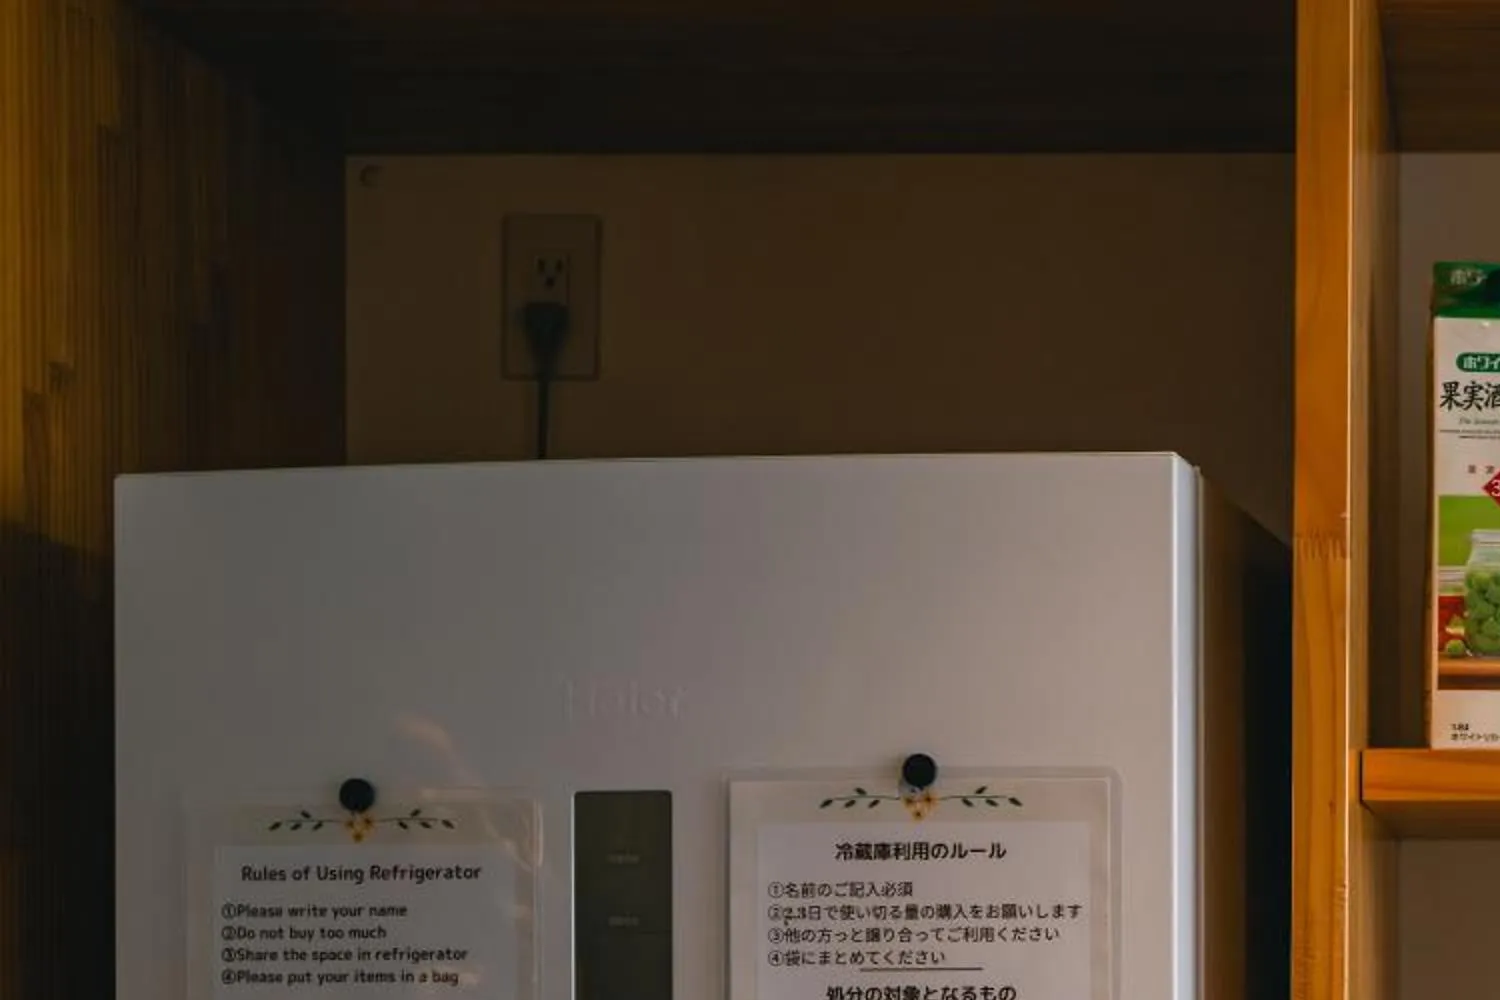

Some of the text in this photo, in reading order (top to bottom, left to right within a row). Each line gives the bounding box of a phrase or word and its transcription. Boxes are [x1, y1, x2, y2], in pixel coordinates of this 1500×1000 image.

[835, 842, 1007, 861] 冷蔵庫利用のルール
[241, 865, 481, 884] Rules of Using Refrigerator
[288, 904, 327, 918] write
[332, 906, 363, 921] your
[369, 906, 407, 917] name
[260, 927, 284, 939] not
[289, 926, 315, 942] buy
[320, 927, 344, 939] too
[348, 926, 387, 939] much
[283, 948, 307, 961] the
[312, 950, 352, 963] space
[357, 948, 371, 961] in
[376, 947, 468, 964] refrigerator
[768, 950, 946, 967] ④袋にまとめてください
[288, 971, 313, 986] put
[318, 972, 349, 987] your
[354, 970, 396, 984] items
[401, 970, 415, 983] in
[419, 972, 427, 983] a
[432, 970, 459, 987] bag
